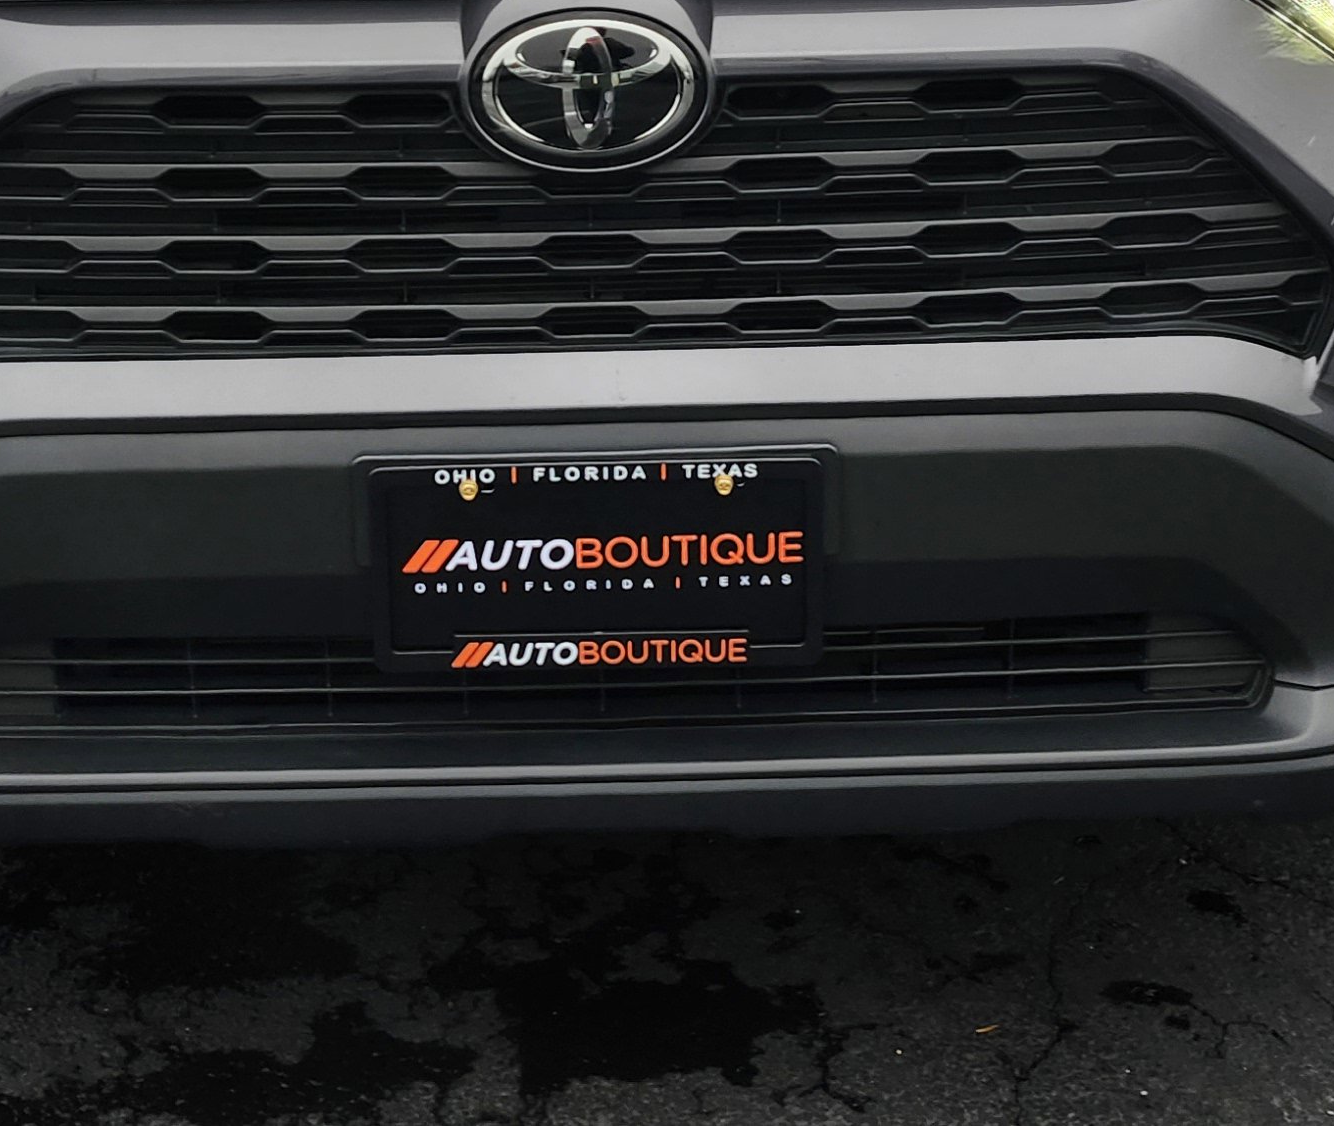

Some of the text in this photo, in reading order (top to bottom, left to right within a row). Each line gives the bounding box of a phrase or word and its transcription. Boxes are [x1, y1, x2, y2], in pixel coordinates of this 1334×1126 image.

[434, 463, 758, 485] OHIO FLORIDA TEXAS
[445, 531, 804, 572] AUTOBOUTIQUE
[414, 574, 793, 594] OHIO FLORIDA TEXAS
[481, 638, 748, 667] AUTOBOUTIQUE
